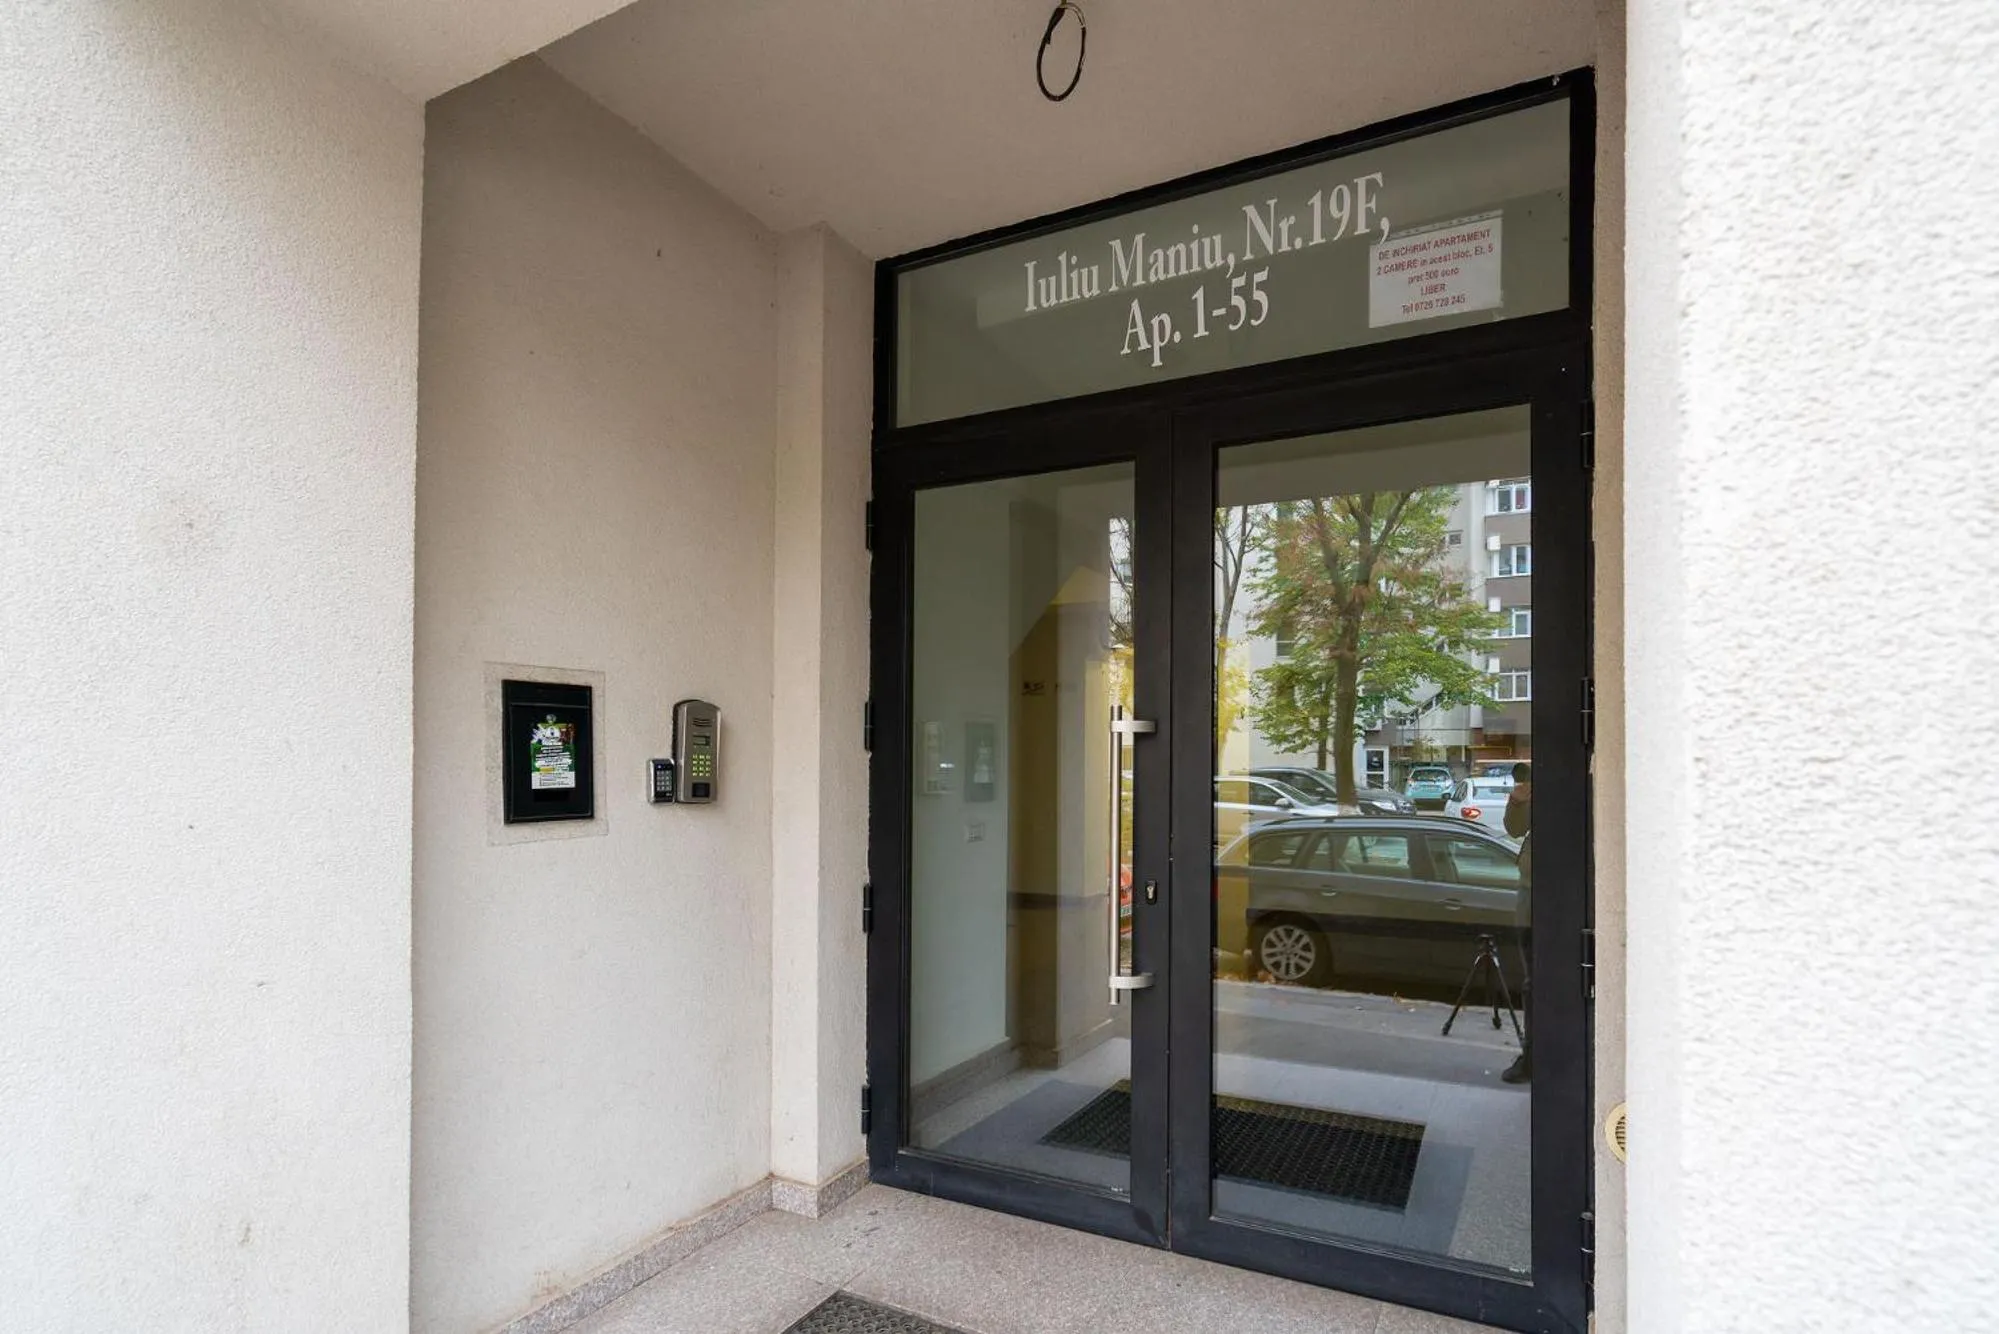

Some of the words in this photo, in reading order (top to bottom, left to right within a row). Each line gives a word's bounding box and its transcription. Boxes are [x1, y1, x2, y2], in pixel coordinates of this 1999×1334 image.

[1024, 250, 1101, 312] Iuliu
[1108, 224, 1236, 293] Maniu,
[1378, 249, 1390, 261] DE
[1392, 241, 1431, 258] INCHIRIAT
[1433, 229, 1492, 249] APARTAMENT
[1383, 258, 1419, 275] CAMERE
[1119, 298, 1182, 368] Ap.
[1191, 265, 1270, 338] 1-55
